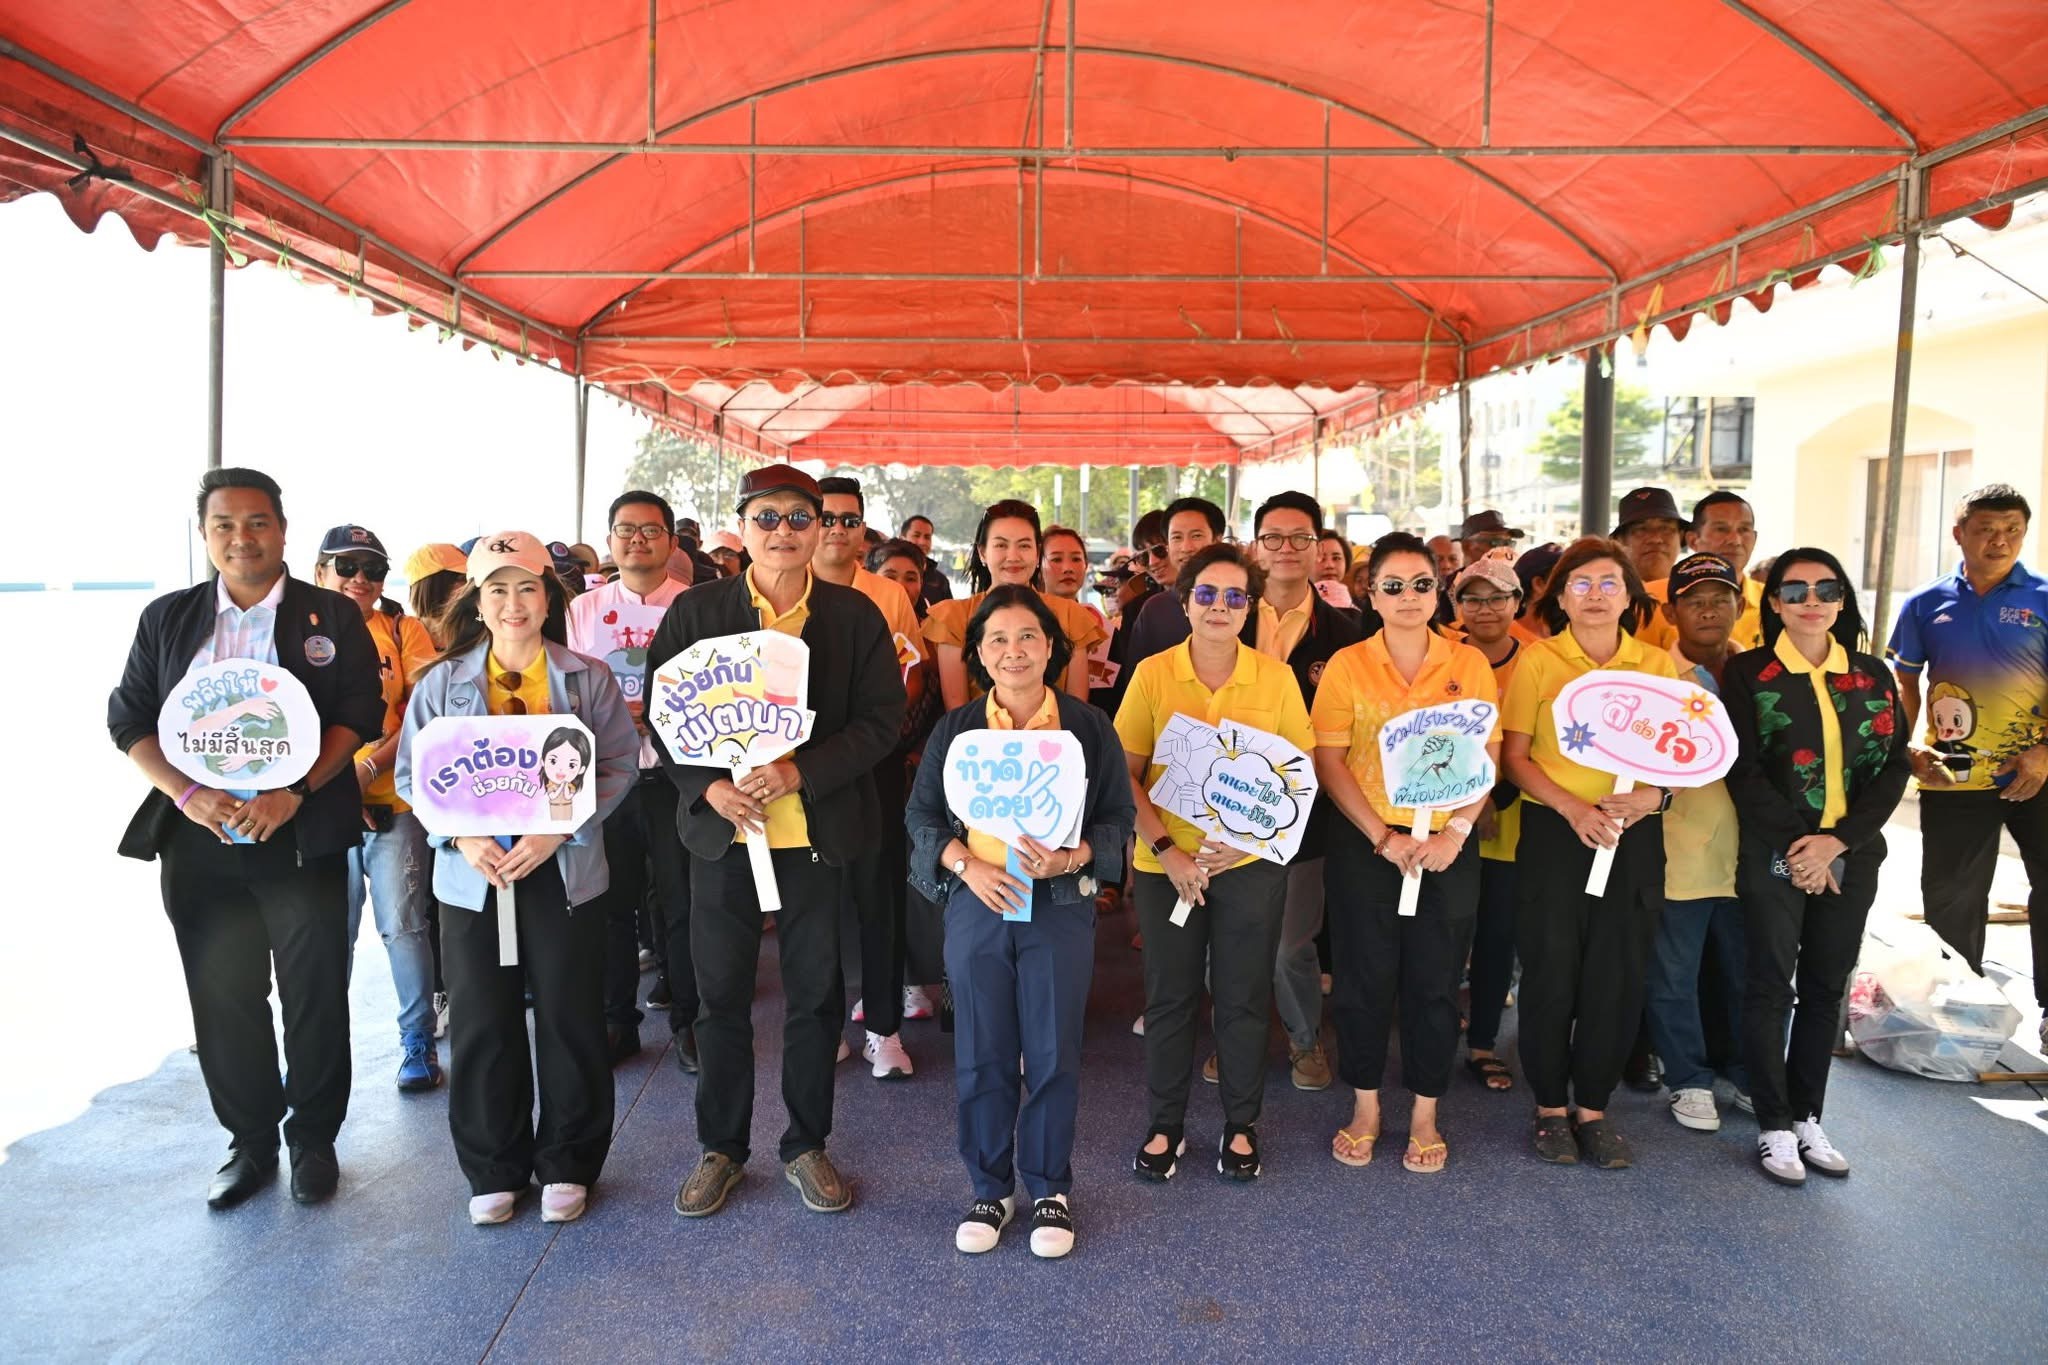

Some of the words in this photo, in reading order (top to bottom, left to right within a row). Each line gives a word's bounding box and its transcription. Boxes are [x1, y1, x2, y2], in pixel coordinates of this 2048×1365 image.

[662, 654, 753, 713] ช่วยกัน
[178, 726, 292, 762] ไม่มีสิ้นสุด
[677, 700, 802, 751] พัฒนา
[429, 737, 539, 795] เราต้อง
[955, 741, 1023, 782] ทำดี
[471, 771, 539, 799] ช่วยกัน
[968, 782, 1033, 819] ด้วย
